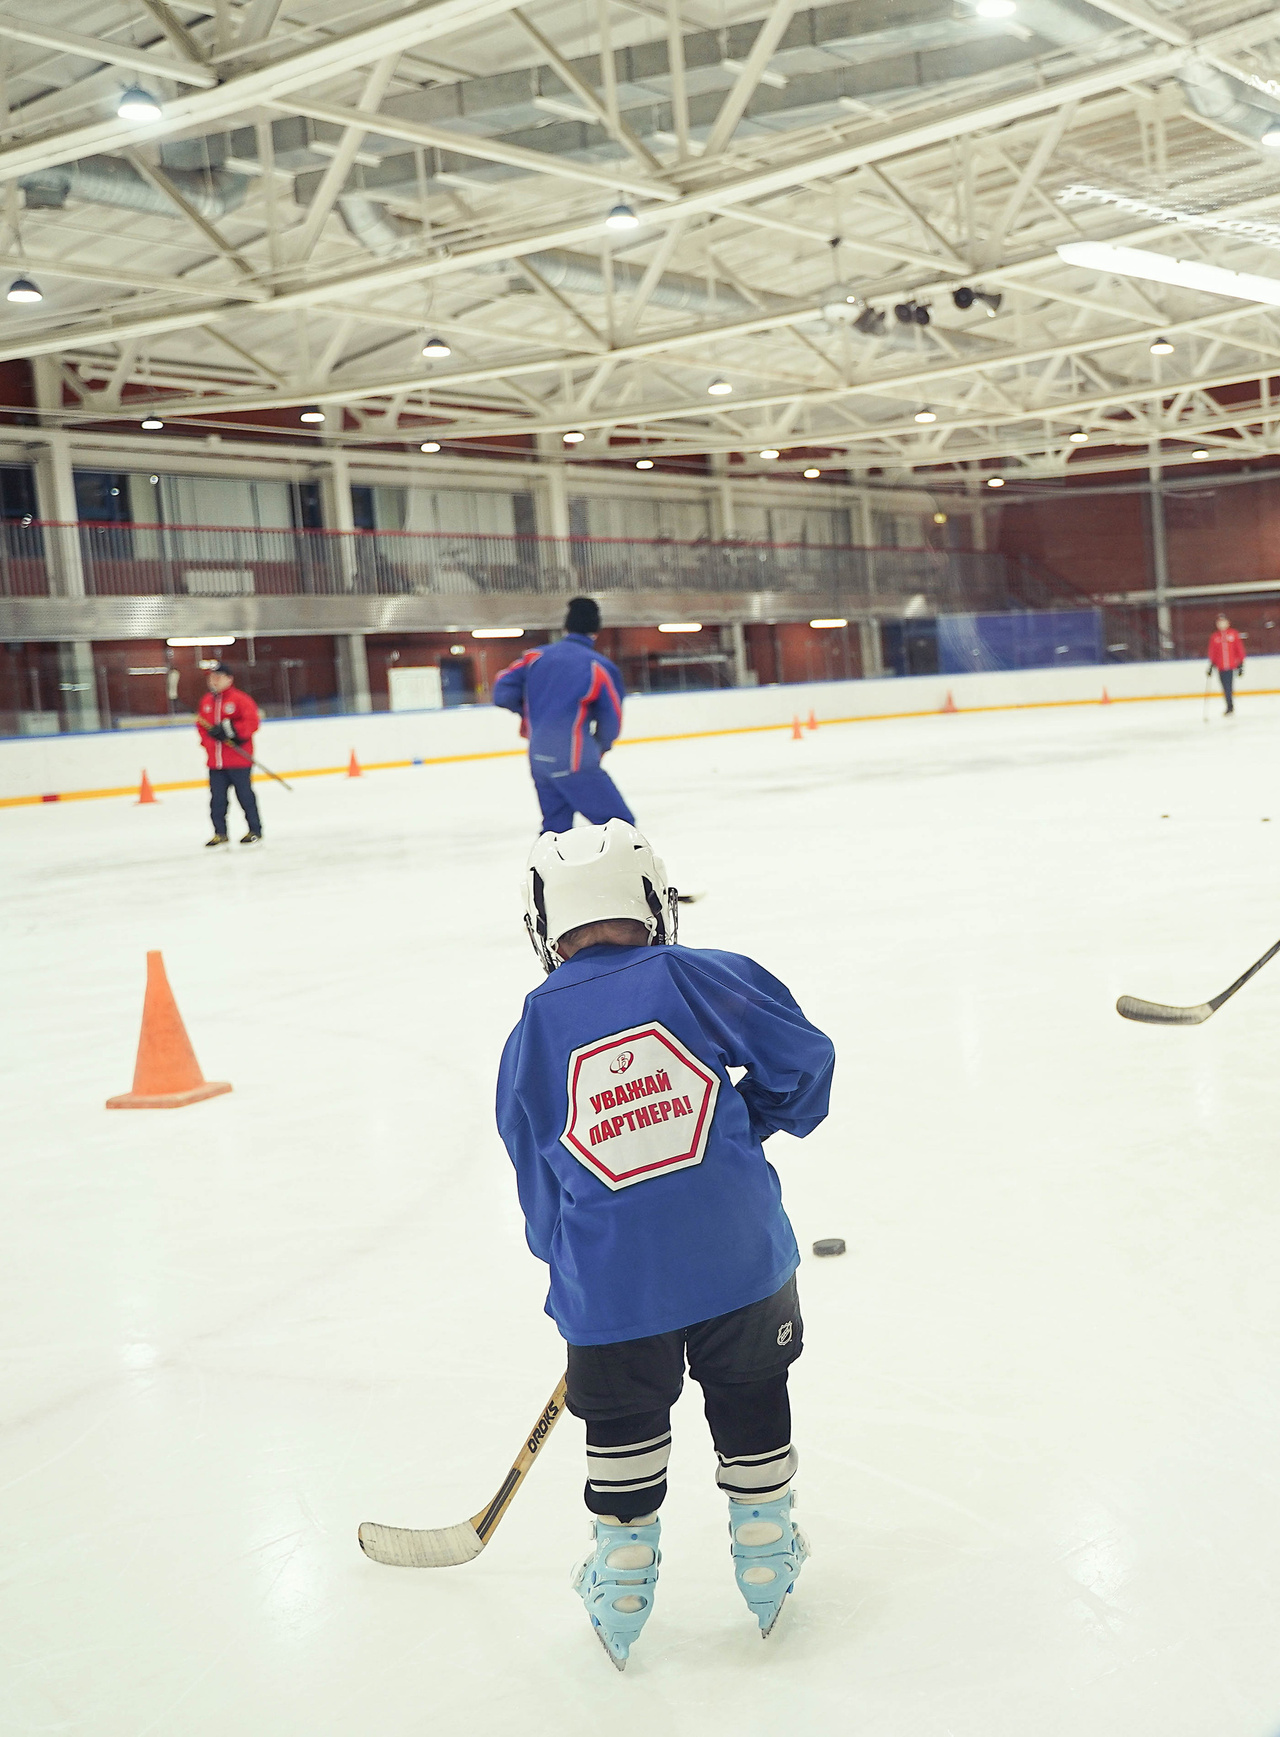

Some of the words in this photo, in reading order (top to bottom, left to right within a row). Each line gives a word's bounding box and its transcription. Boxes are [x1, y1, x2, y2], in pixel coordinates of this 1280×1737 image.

[589, 1069, 673, 1115] УВАЖАЙ
[589, 1095, 694, 1146] ПАРТНЕРА!
[527, 1400, 560, 1453] OROKS
